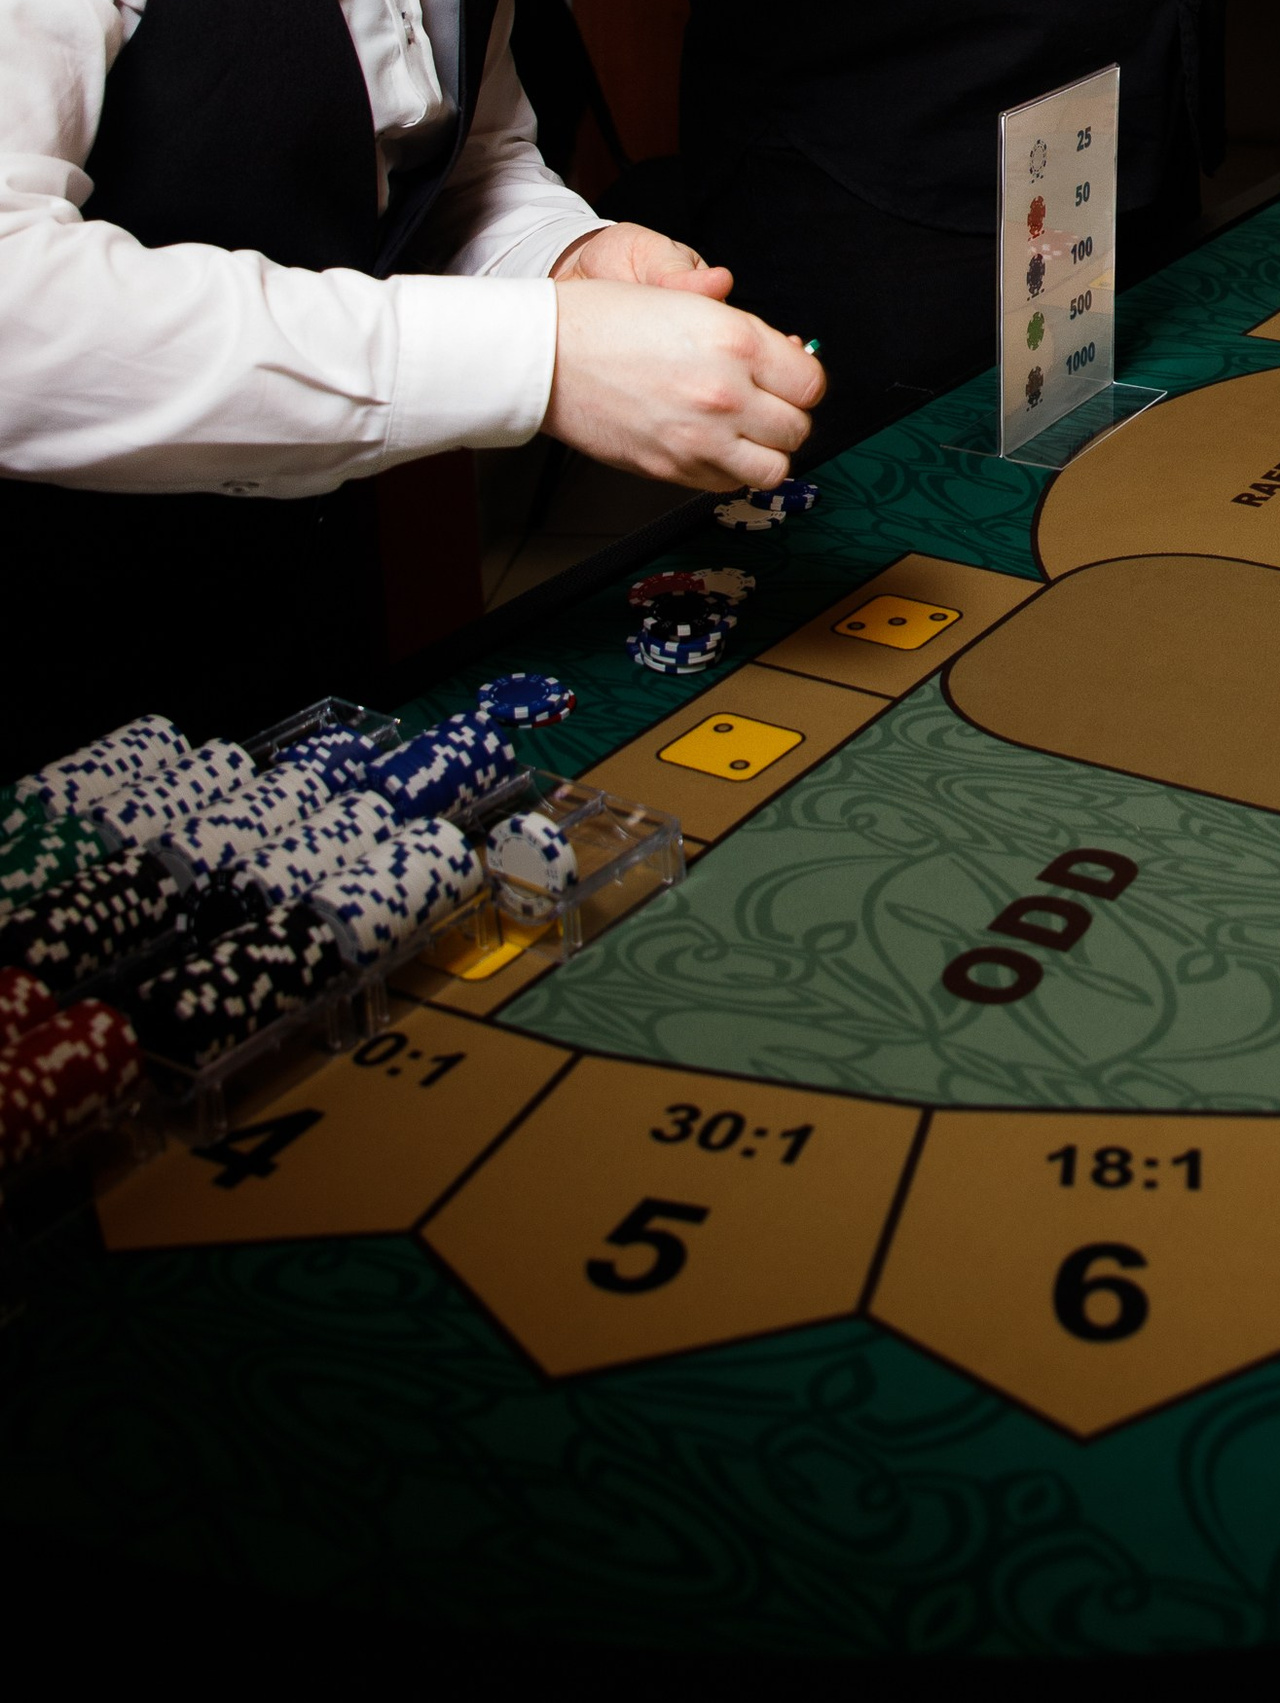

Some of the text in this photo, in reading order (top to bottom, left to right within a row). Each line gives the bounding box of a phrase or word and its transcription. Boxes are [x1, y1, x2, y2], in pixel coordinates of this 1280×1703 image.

[1076, 126, 1092, 153] 25
[1075, 181, 1091, 207] 50
[1070, 236, 1093, 265] 100
[1069, 290, 1092, 321] 500
[1065, 342, 1096, 376] 1000
[941, 848, 1139, 1005] ODD
[190, 1108, 325, 1189] 4
[650, 1103, 815, 1166] 30:1
[1045, 1144, 1204, 1192] 18:1
[584, 1197, 711, 1296] 5
[1051, 1240, 1151, 1344] 6
